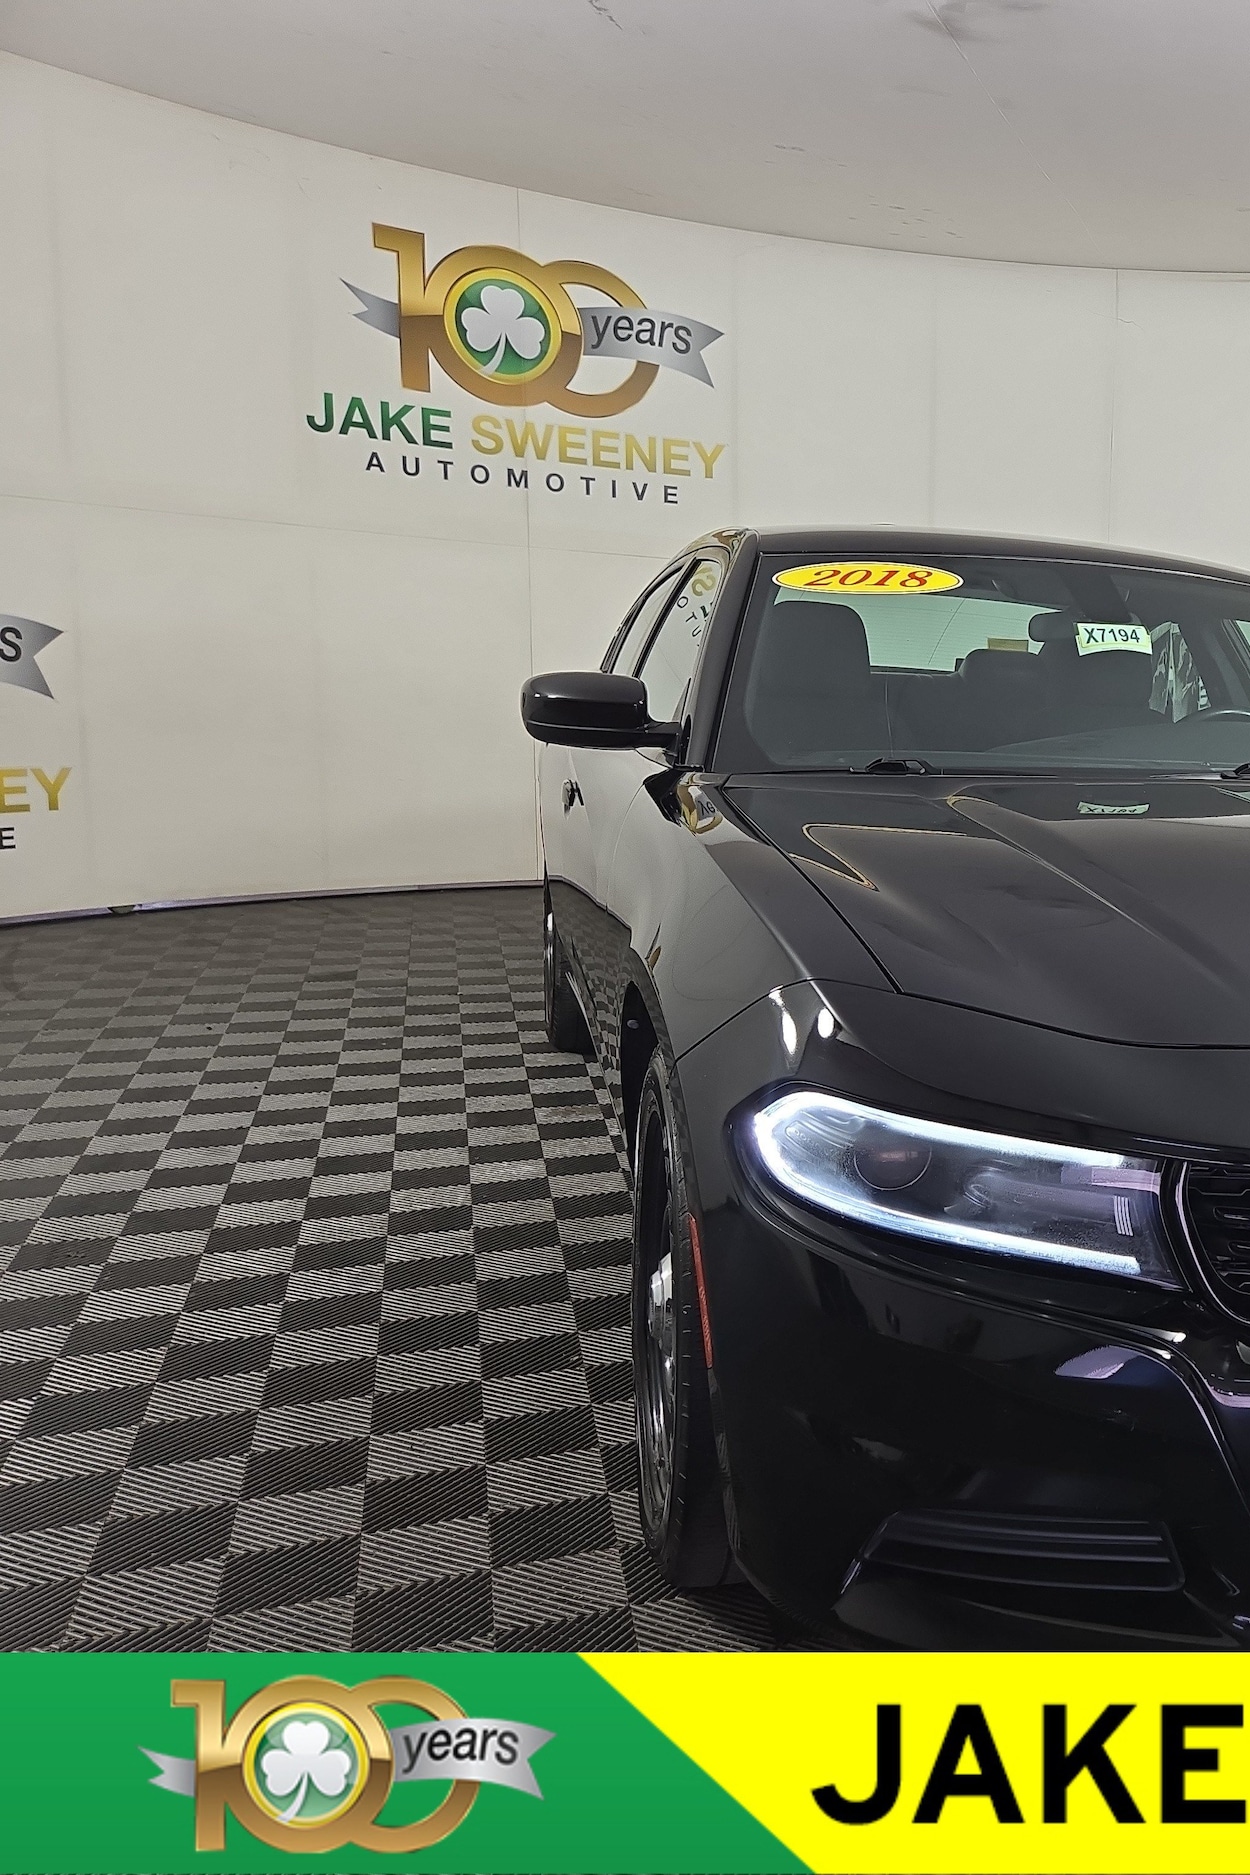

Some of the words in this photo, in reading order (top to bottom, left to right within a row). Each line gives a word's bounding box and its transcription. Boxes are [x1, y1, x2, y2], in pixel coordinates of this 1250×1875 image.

[591, 311, 693, 355] years
[306, 392, 453, 450] JAKE
[470, 415, 726, 480] SWEENEY
[365, 452, 679, 505] AUTOMOTIVE
[804, 569, 932, 588] 2018
[1084, 628, 1140, 644] X7194
